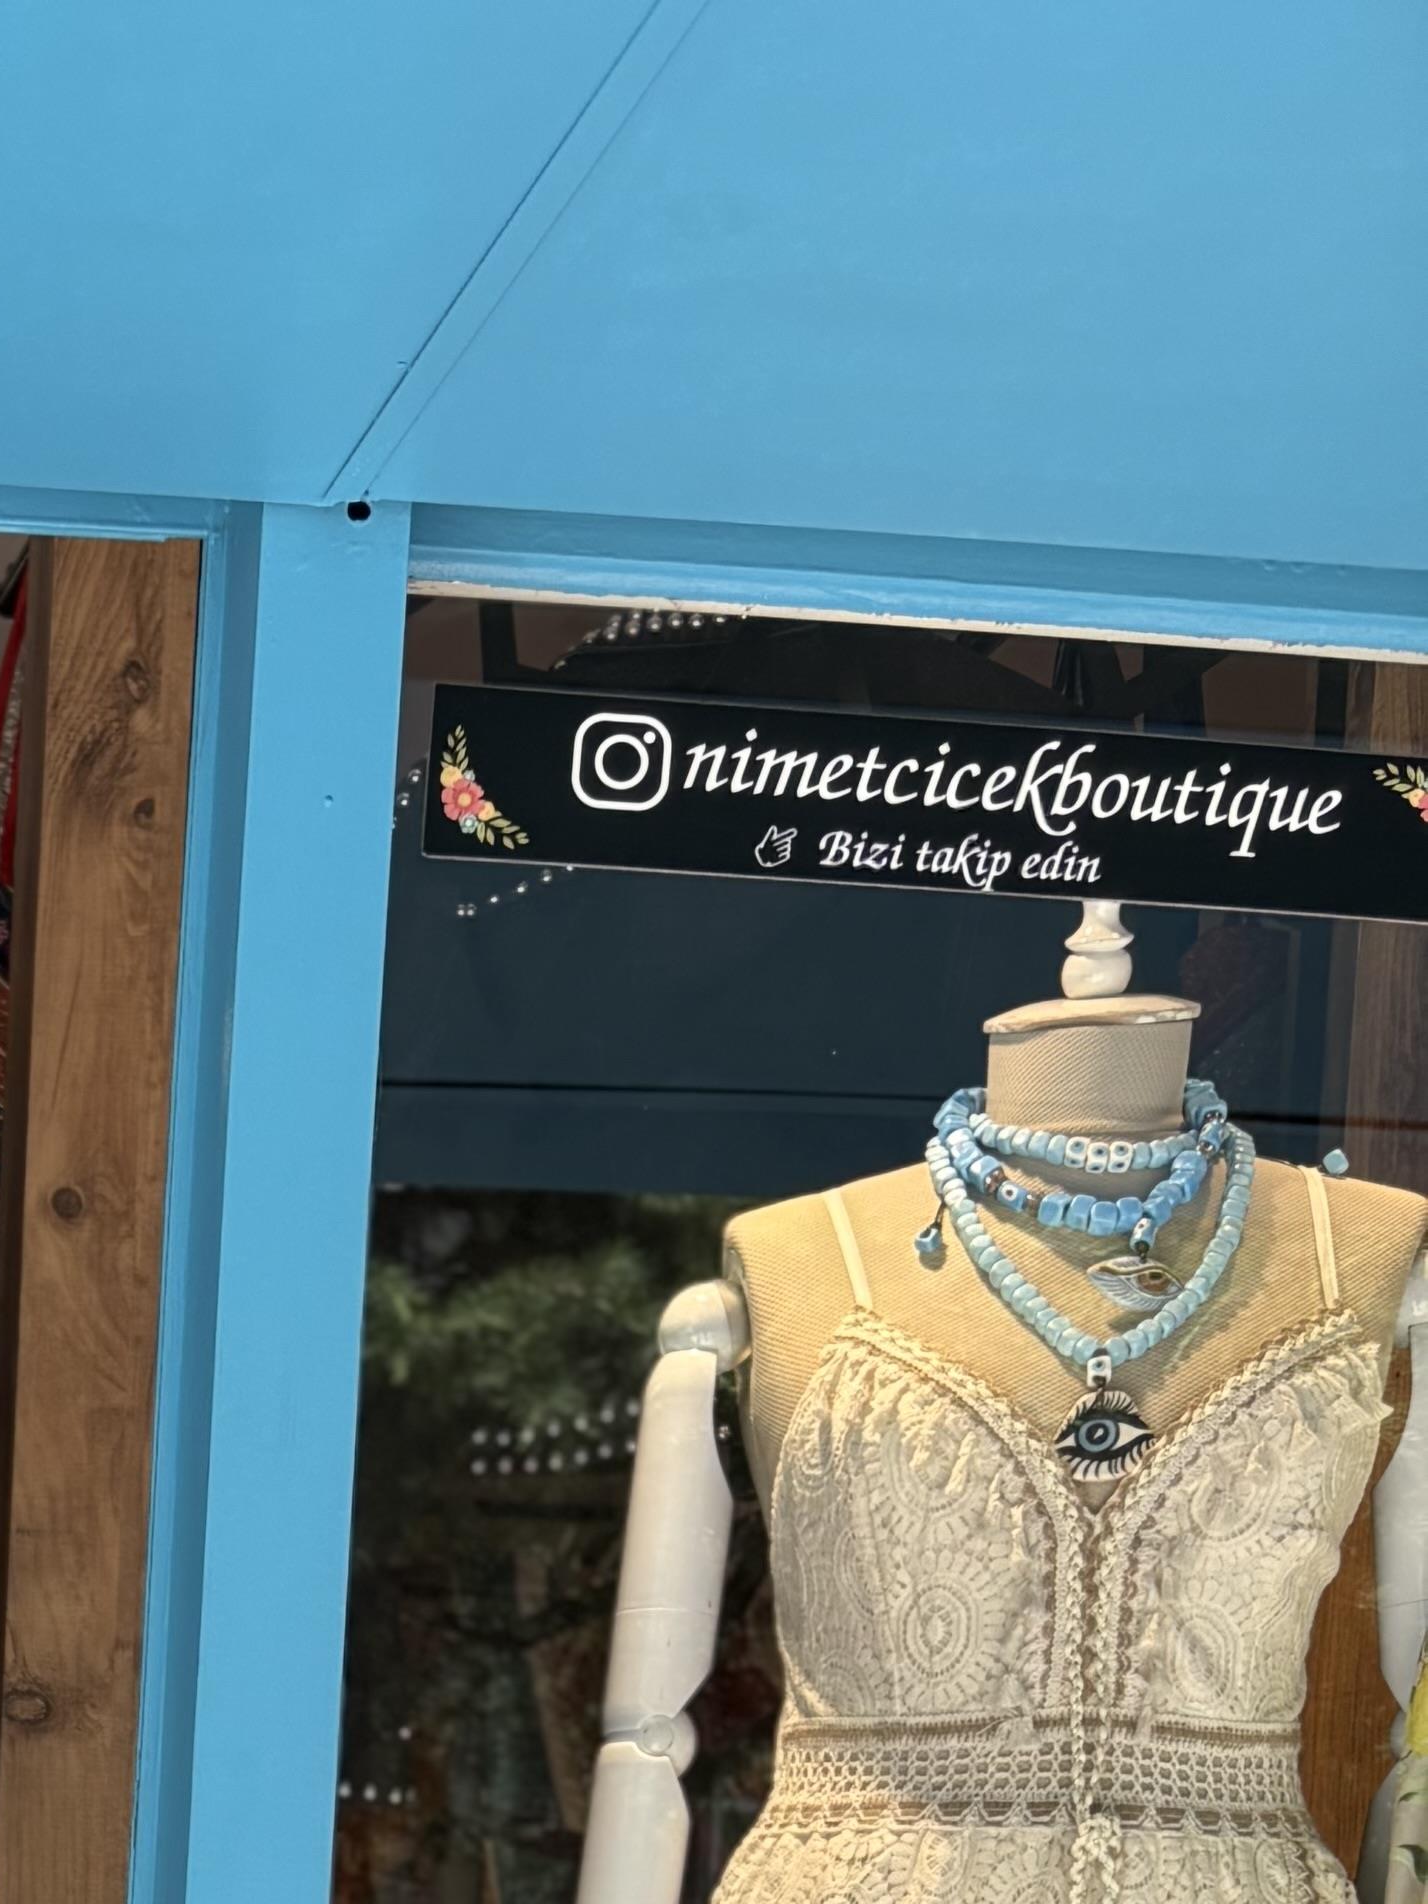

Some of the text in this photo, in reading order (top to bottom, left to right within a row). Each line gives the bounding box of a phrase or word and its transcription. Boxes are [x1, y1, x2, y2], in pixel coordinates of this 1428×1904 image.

[683, 728, 1343, 858] nimetcicekboutique
[819, 830, 1101, 891] Bizi takip edin
